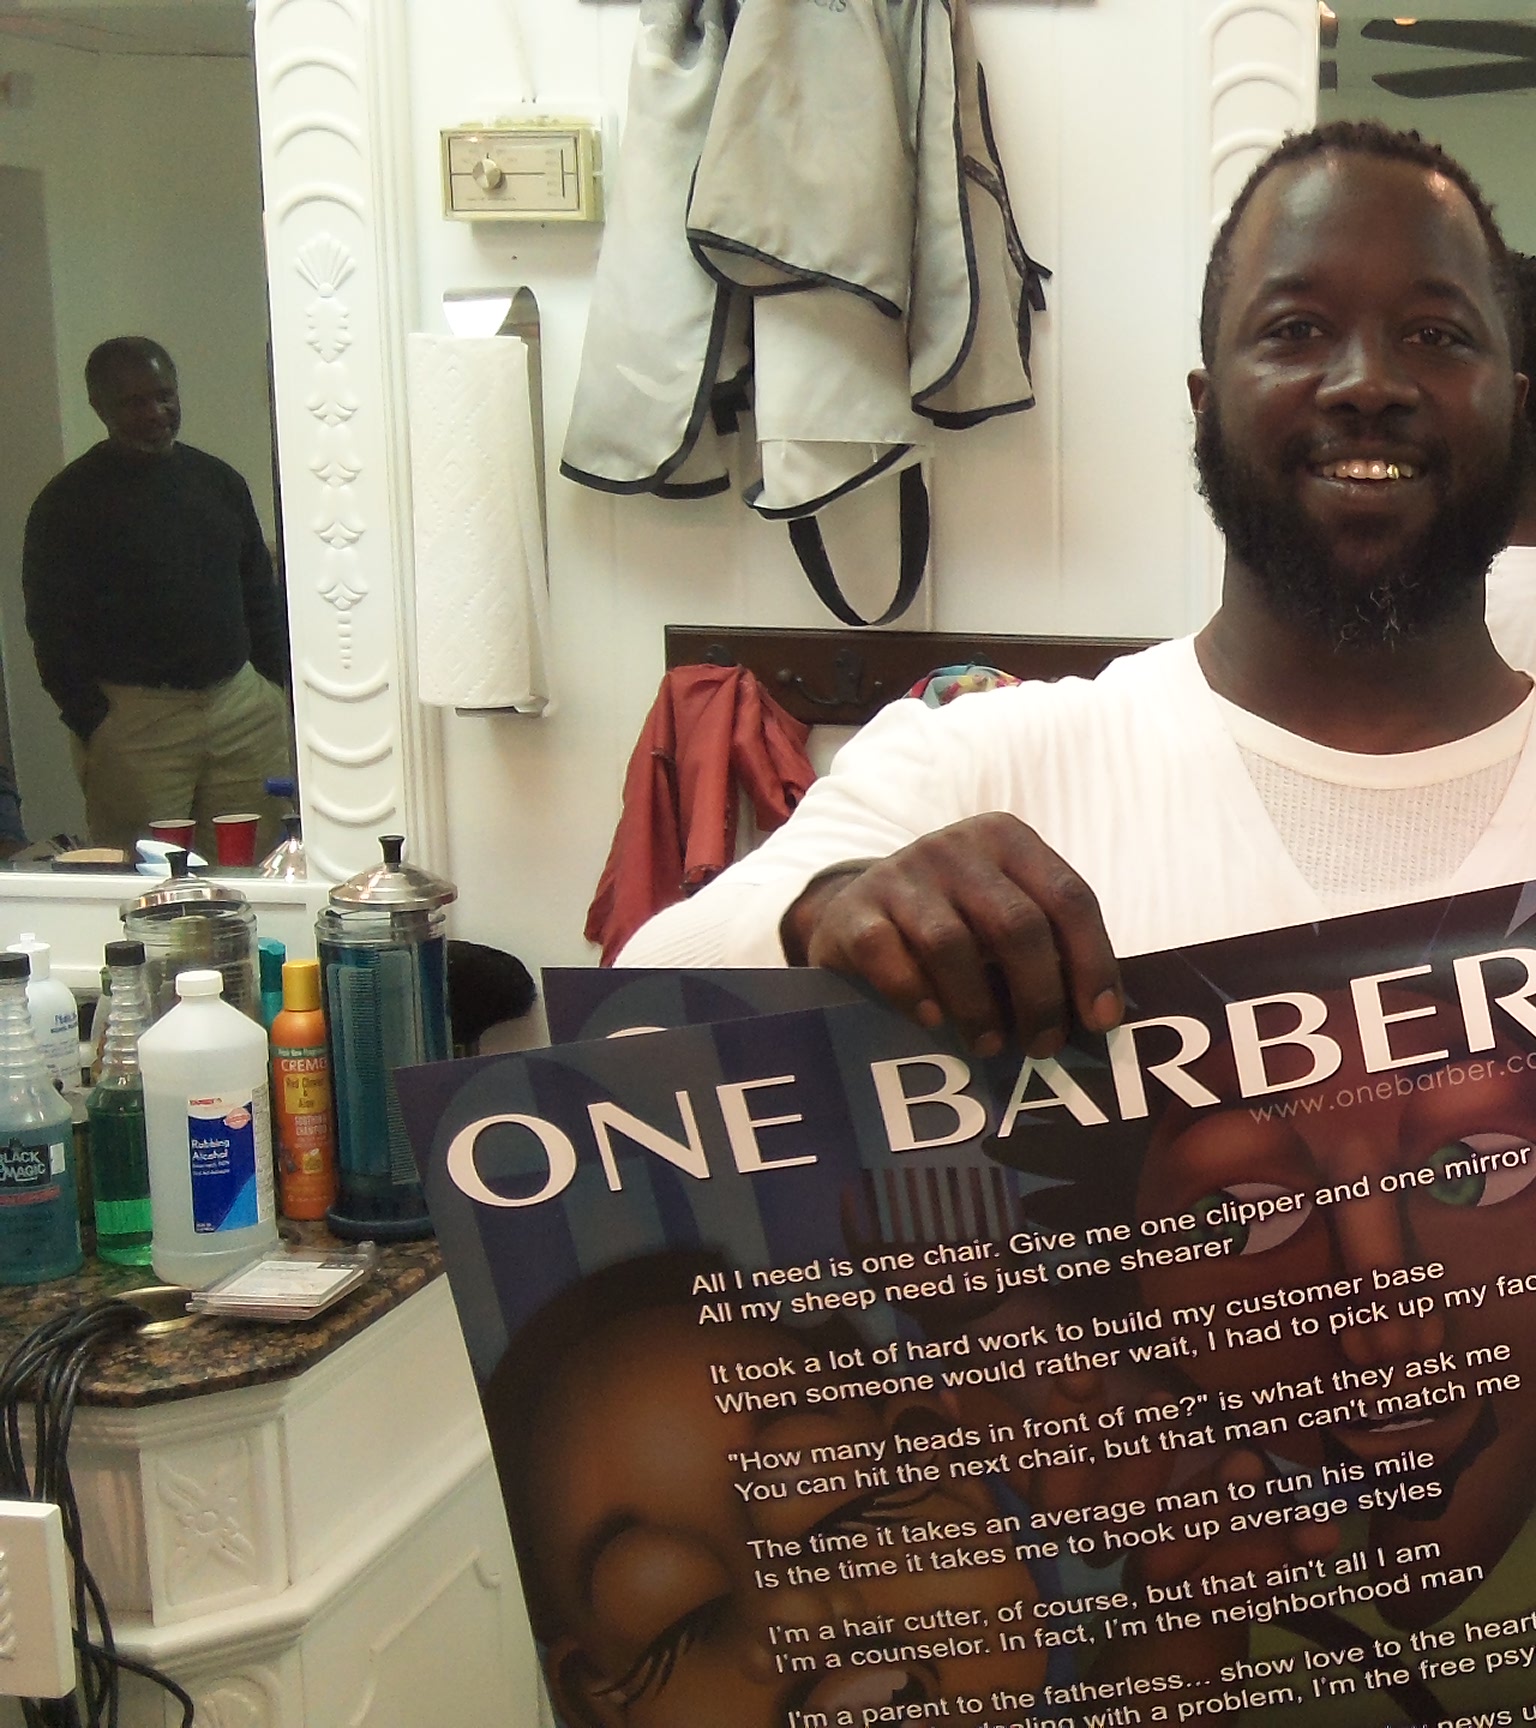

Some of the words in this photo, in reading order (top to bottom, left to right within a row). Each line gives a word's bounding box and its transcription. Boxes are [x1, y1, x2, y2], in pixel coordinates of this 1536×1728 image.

[0, 1151, 41, 1164] LACK
[3, 1163, 47, 1181] MAGIC
[191, 1138, 230, 1149] Rubbing
[192, 1149, 229, 1160] Alcohol
[447, 1074, 818, 1208] ONE
[692, 1272, 725, 1295] All
[734, 1271, 742, 1289] I
[752, 1260, 821, 1287] need
[829, 1258, 854, 1277] is
[862, 1253, 915, 1273] one
[924, 1239, 1000, 1265] chair.
[1010, 1232, 1076, 1254] Give
[1086, 1225, 1131, 1245] me
[1141, 1214, 1195, 1236] one
[1206, 1187, 1305, 1225] clipper
[1315, 1176, 1370, 1205] and
[1380, 1168, 1435, 1192] one
[1445, 1148, 1530, 1179] mirror
[699, 1302, 732, 1325] All
[741, 1301, 782, 1322] my
[791, 1289, 876, 1313] sheep
[885, 1274, 955, 1301] need
[963, 1272, 988, 1292] is
[996, 1264, 1049, 1293] just
[1057, 1259, 1110, 1279] one
[1120, 1238, 1233, 1270] shearer
[710, 1365, 729, 1384] It
[735, 1357, 796, 1381] took
[805, 1358, 821, 1373] a
[829, 1348, 864, 1370] lot
[872, 1343, 898, 1364] of
[906, 1335, 970, 1360] hard
[978, 1326, 1048, 1351] work
[1055, 1323, 1083, 1342] to
[1092, 1309, 1162, 1337] build
[1173, 1304, 1215, 1326] my
[1226, 1278, 1363, 1316] customer
[1372, 1263, 1445, 1290] base
[715, 1391, 797, 1414] When
[806, 1375, 934, 1403] someone
[941, 1359, 1026, 1386] would
[1036, 1350, 1120, 1375] rather
[1129, 1337, 1198, 1362] wait,
[1208, 1331, 1215, 1350] I
[1225, 1320, 1281, 1348] had
[1291, 1317, 1319, 1336] to
[1329, 1302, 1389, 1334] pick
[1398, 1297, 1434, 1318] up
[1444, 1285, 1486, 1307] my
[728, 1451, 801, 1471] "How
[811, 1440, 885, 1463] many
[894, 1427, 981, 1453] heads
[989, 1424, 1014, 1443] in
[1023, 1413, 1090, 1438] front
[1098, 1406, 1124, 1428] of
[1135, 1394, 1207, 1423] me?"
[1219, 1392, 1243, 1410] is
[1252, 1376, 1324, 1404] what
[1332, 1366, 1394, 1391] they
[1406, 1352, 1456, 1378] ask
[1466, 1345, 1510, 1366] me
[734, 1482, 787, 1501] You
[797, 1476, 846, 1494] can
[855, 1467, 889, 1488] hit
[896, 1464, 940, 1483] the
[950, 1454, 1011, 1478] next
[1019, 1444, 1096, 1469] chair,
[1104, 1435, 1152, 1458] but
[1158, 1425, 1216, 1450] that
[1225, 1417, 1287, 1441] man
[1298, 1399, 1368, 1427] can't
[1377, 1381, 1466, 1414] match
[1477, 1374, 1520, 1396] me
[747, 1539, 802, 1559] The
[809, 1533, 868, 1553] time
[876, 1527, 894, 1546] it
[902, 1521, 977, 1543] takes
[986, 1516, 1020, 1533] an
[1031, 1501, 1145, 1528] average
[1156, 1490, 1218, 1512] man
[1227, 1483, 1255, 1500] to
[1266, 1474, 1312, 1495] run
[1322, 1463, 1364, 1485] his
[1375, 1450, 1434, 1476] mile
[755, 1570, 779, 1588] Is
[787, 1566, 830, 1585] the
[839, 1560, 897, 1579] time
[906, 1553, 923, 1572] it
[930, 1548, 1006, 1569] takes
[1016, 1542, 1059, 1560] me
[1067, 1536, 1094, 1554] to
[1103, 1523, 1175, 1549] hook
[1184, 1520, 1219, 1540] up
[1231, 1499, 1347, 1531] average
[1358, 1482, 1442, 1510] styles
[769, 1626, 809, 1644] I'm
[819, 1626, 835, 1640] a
[843, 1615, 895, 1637] hair
[905, 1610, 989, 1631] cutter,
[998, 1601, 1023, 1622] of
[1033, 1593, 1138, 1618] course,
[1146, 1580, 1193, 1603] but
[1201, 1571, 1257, 1595] that
[1266, 1560, 1326, 1586] ain't
[1335, 1551, 1367, 1574] all
[1377, 1548, 1385, 1566] I
[1396, 1543, 1440, 1563] am
[776, 1654, 816, 1673] I'm
[825, 1654, 841, 1668] a
[851, 1639, 990, 1665] counselor.
[1000, 1633, 1025, 1651] In
[1034, 1624, 1095, 1648] fact,
[1105, 1618, 1147, 1639] I'm
[1155, 1612, 1201, 1632] the
[1212, 1573, 1410, 1624] neighborhood
[1421, 1565, 1483, 1589] man
[788, 1711, 827, 1728] I'm
[837, 1711, 853, 1725] a
[862, 1698, 950, 1728] parent
[956, 1696, 983, 1713] to
[991, 1692, 1035, 1710] the
[1220, 1658, 1295, 1681] show
[1304, 1648, 1364, 1669] love
[1373, 1640, 1401, 1657] to
[1410, 1631, 1455, 1651] the
[1083, 1706, 1142, 1728] with
[1151, 1706, 1168, 1720] a
[1178, 1681, 1303, 1722] problem,
[1313, 1677, 1355, 1697] I'm
[1364, 1669, 1409, 1689] the
[1418, 1658, 1475, 1679] free
